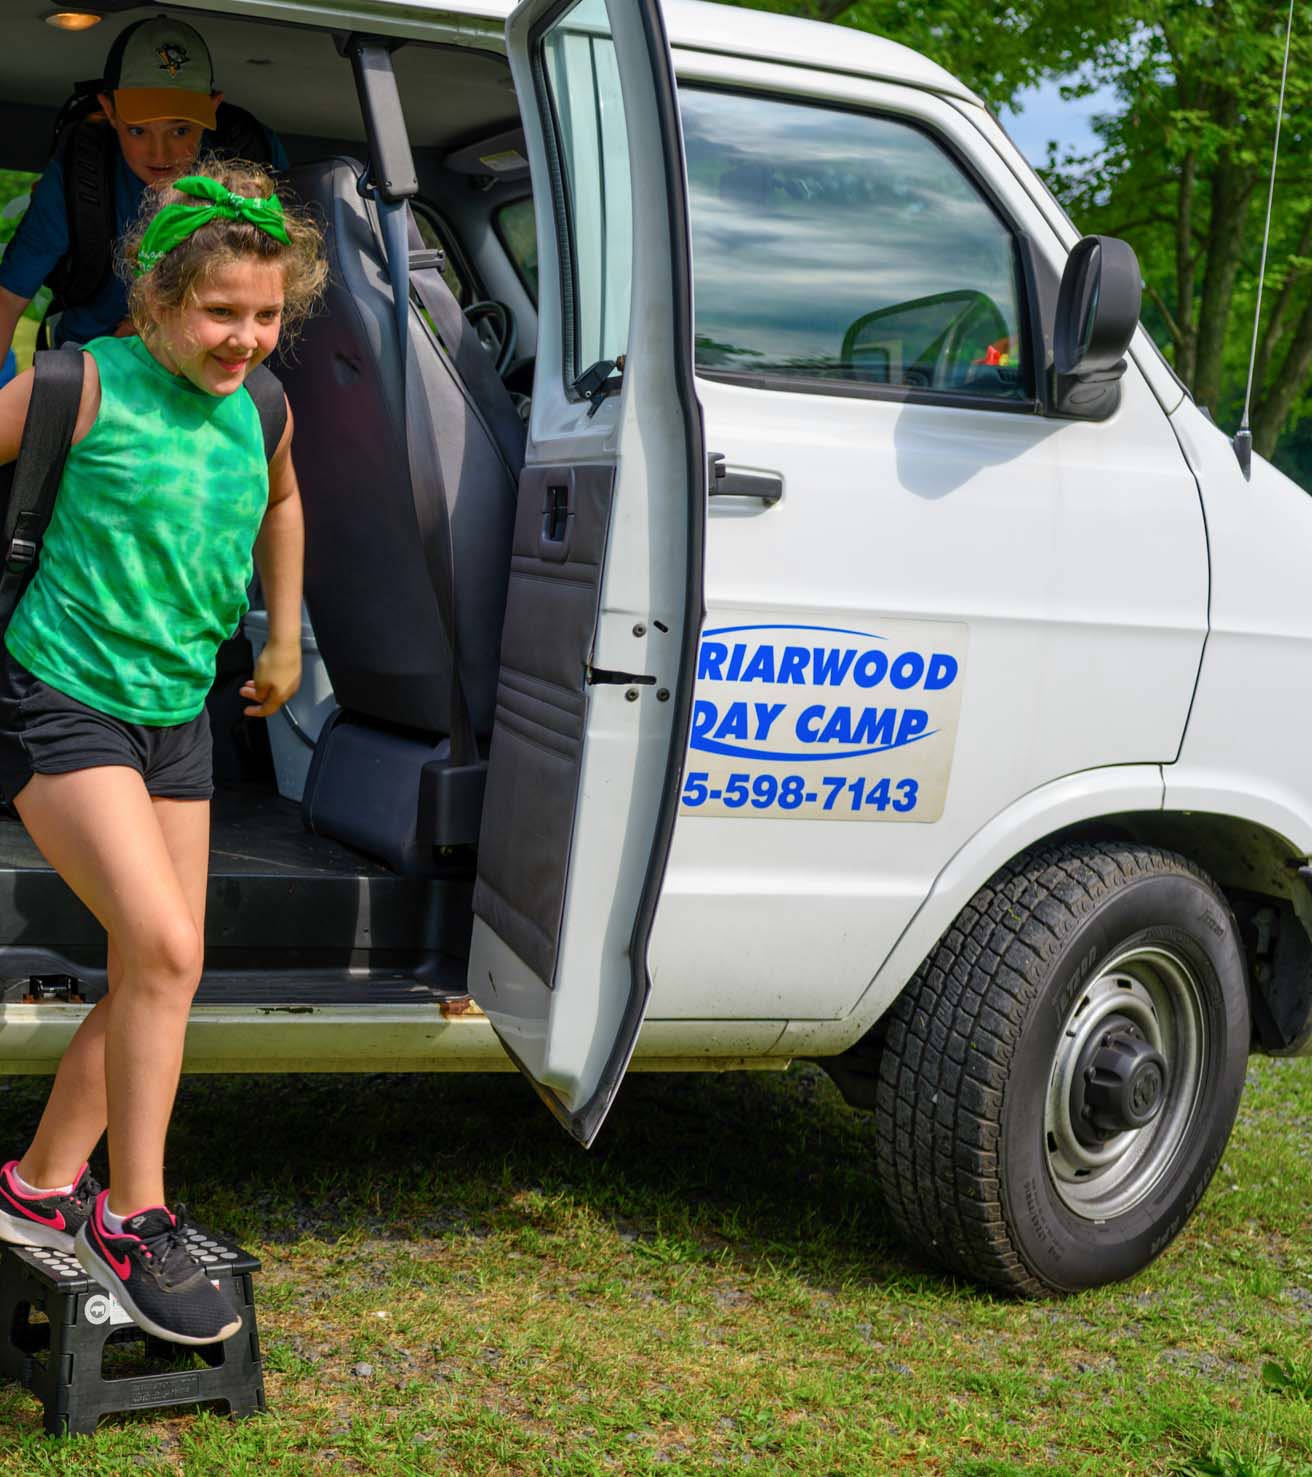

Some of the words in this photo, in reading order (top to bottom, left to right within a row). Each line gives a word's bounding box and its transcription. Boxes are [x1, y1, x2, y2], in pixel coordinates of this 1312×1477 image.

[697, 641, 959, 691] RIARWOOD
[690, 699, 787, 742] DAY
[795, 704, 930, 746] CAMP
[681, 771, 920, 813] 5-598-7143
